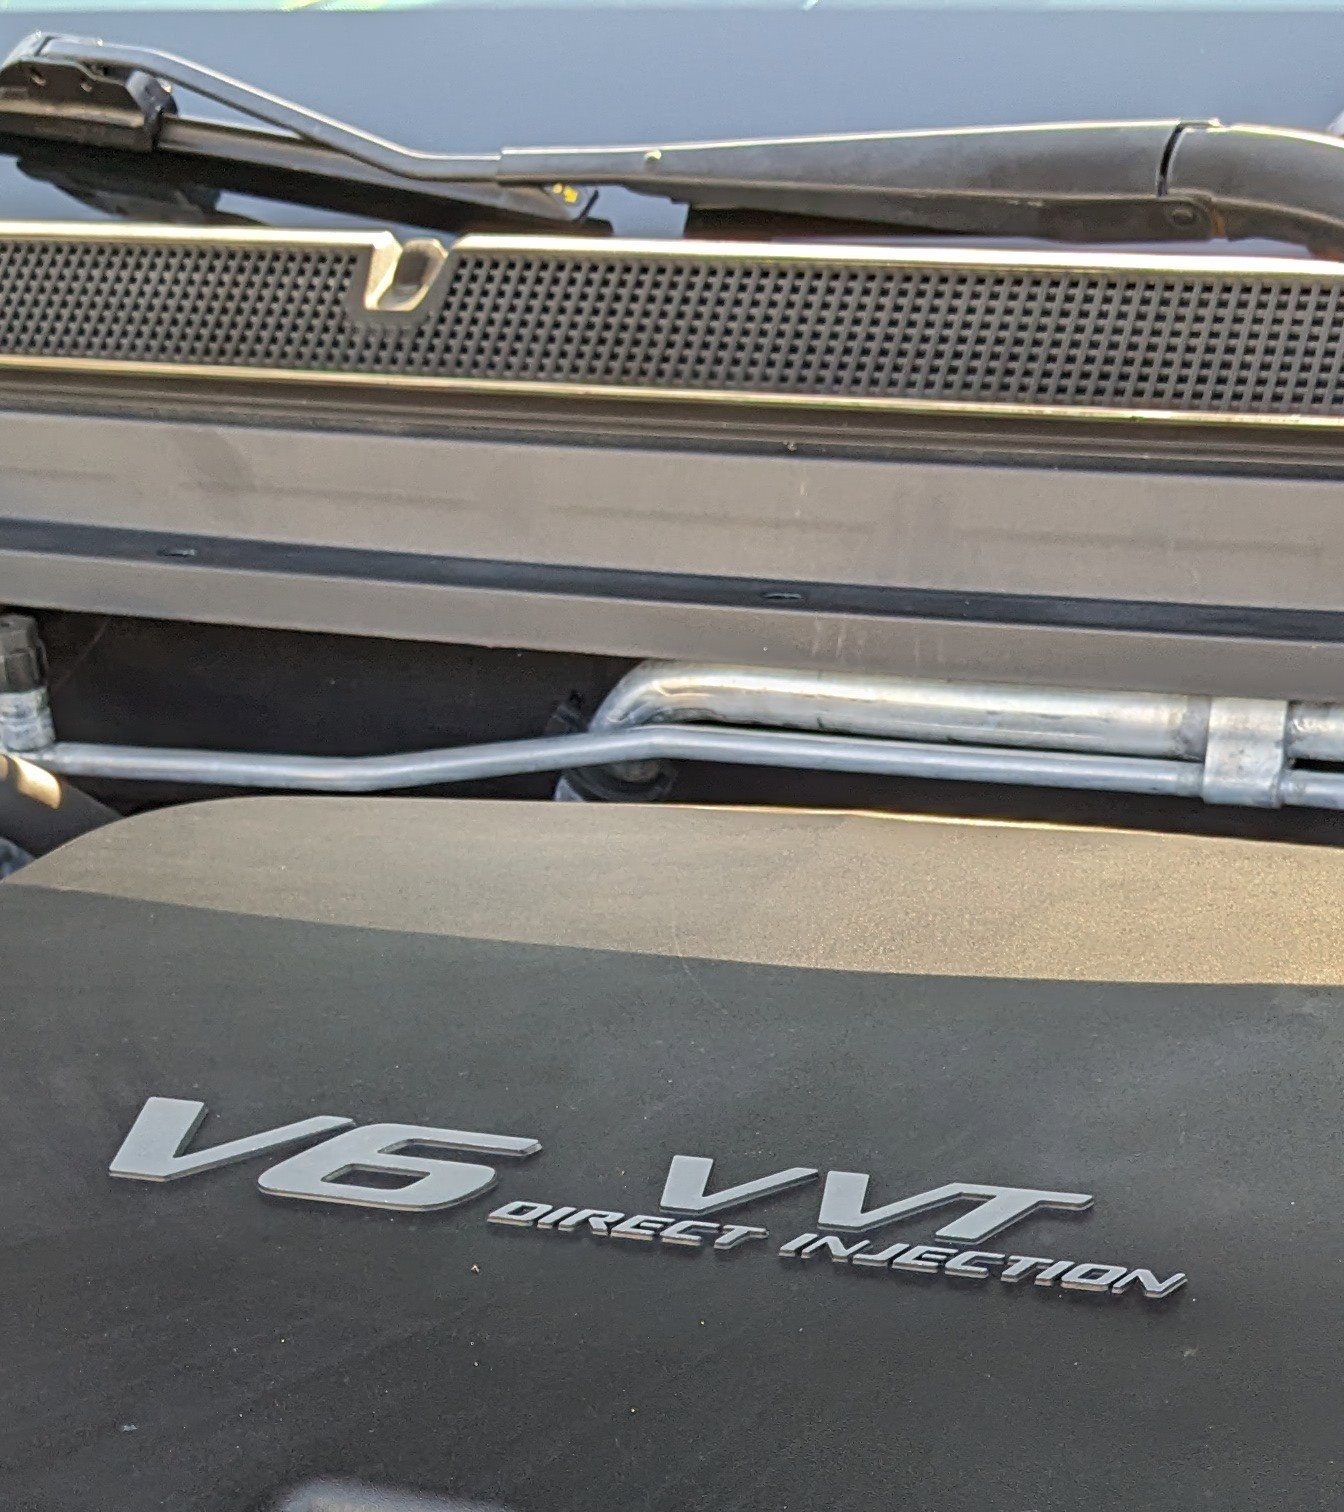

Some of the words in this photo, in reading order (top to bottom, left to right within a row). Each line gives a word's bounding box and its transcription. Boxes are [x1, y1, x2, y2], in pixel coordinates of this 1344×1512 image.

[109, 1096, 542, 1212] V6
[659, 1154, 1095, 1245] VVT
[486, 1200, 769, 1250] DIRECT
[777, 1232, 1187, 1299] INJECTION
